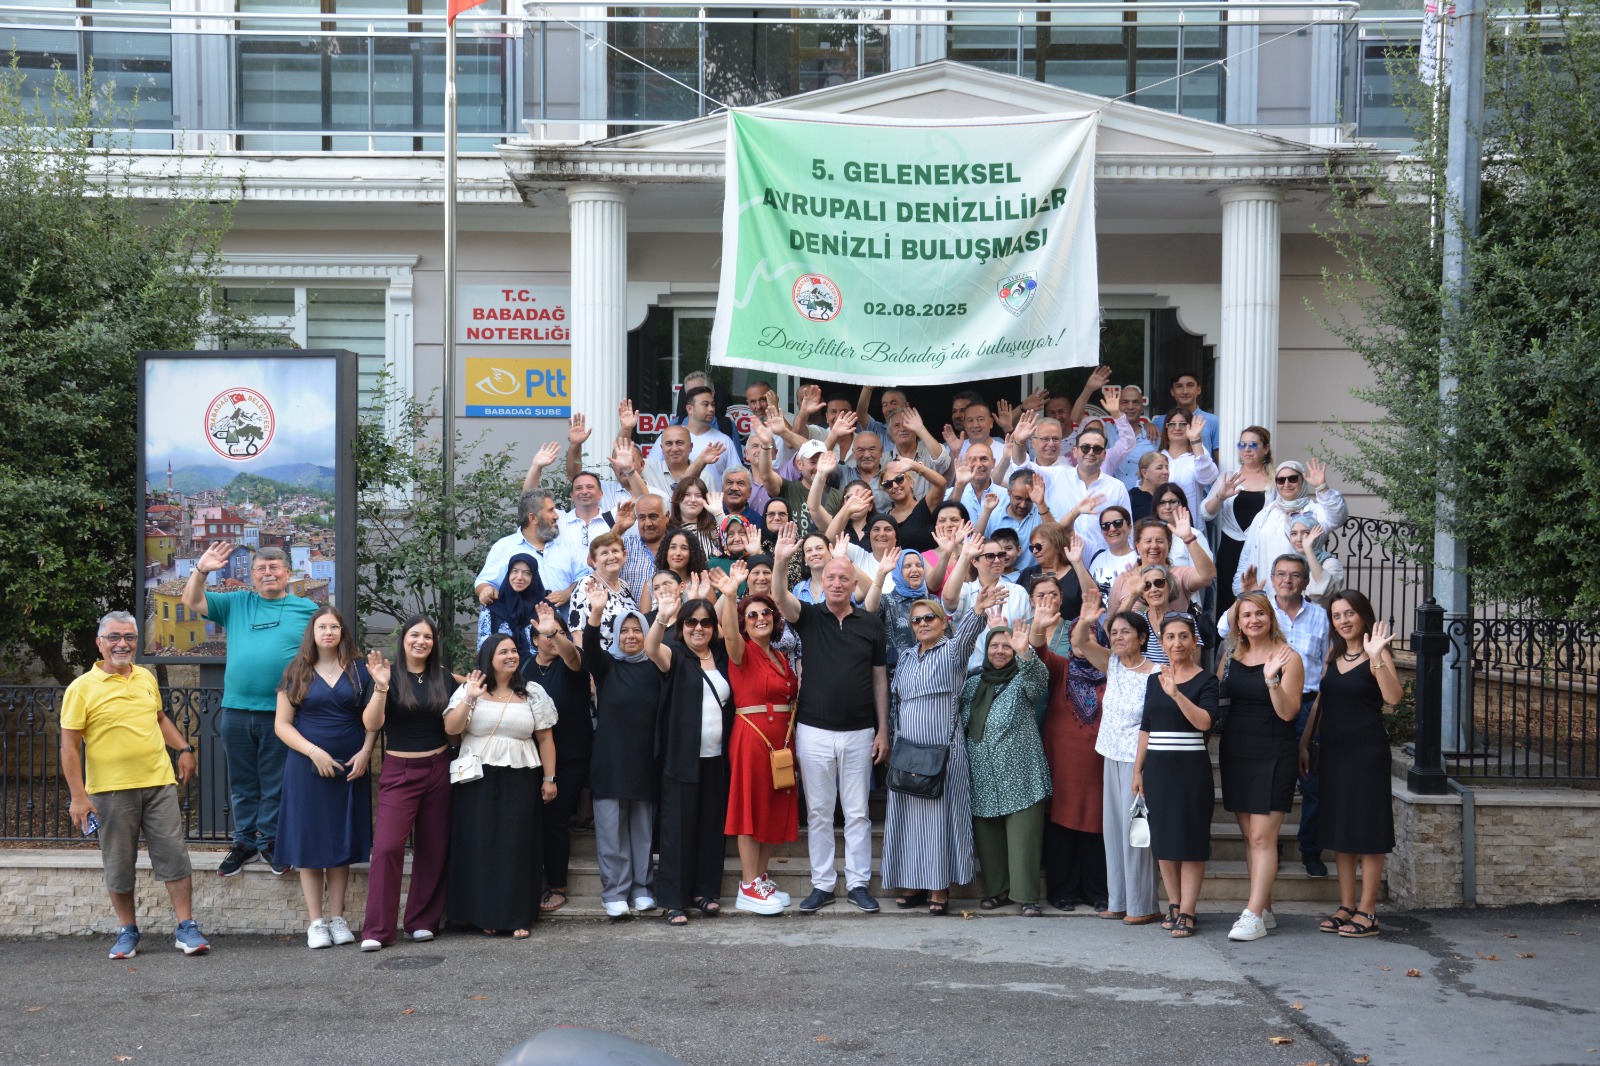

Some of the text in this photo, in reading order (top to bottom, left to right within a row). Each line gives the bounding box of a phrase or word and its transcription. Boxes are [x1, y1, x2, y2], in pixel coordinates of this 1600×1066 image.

[812, 158, 1021, 185] 5. GELENEKSEL
[763, 187, 1067, 223] AVRUPALI DENİZLİLİLER
[790, 228, 1048, 265] DENİZLİ BULUŞMASI
[502, 289, 536, 302] T.C.
[472, 305, 566, 321] BABADAĞ
[863, 302, 967, 317] 02.08.2025
[977, 327, 1067, 359] buluşuyor!
[525, 369, 568, 398] Ptt
[484, 407, 562, 416] BABADAĞ ŞUBE
